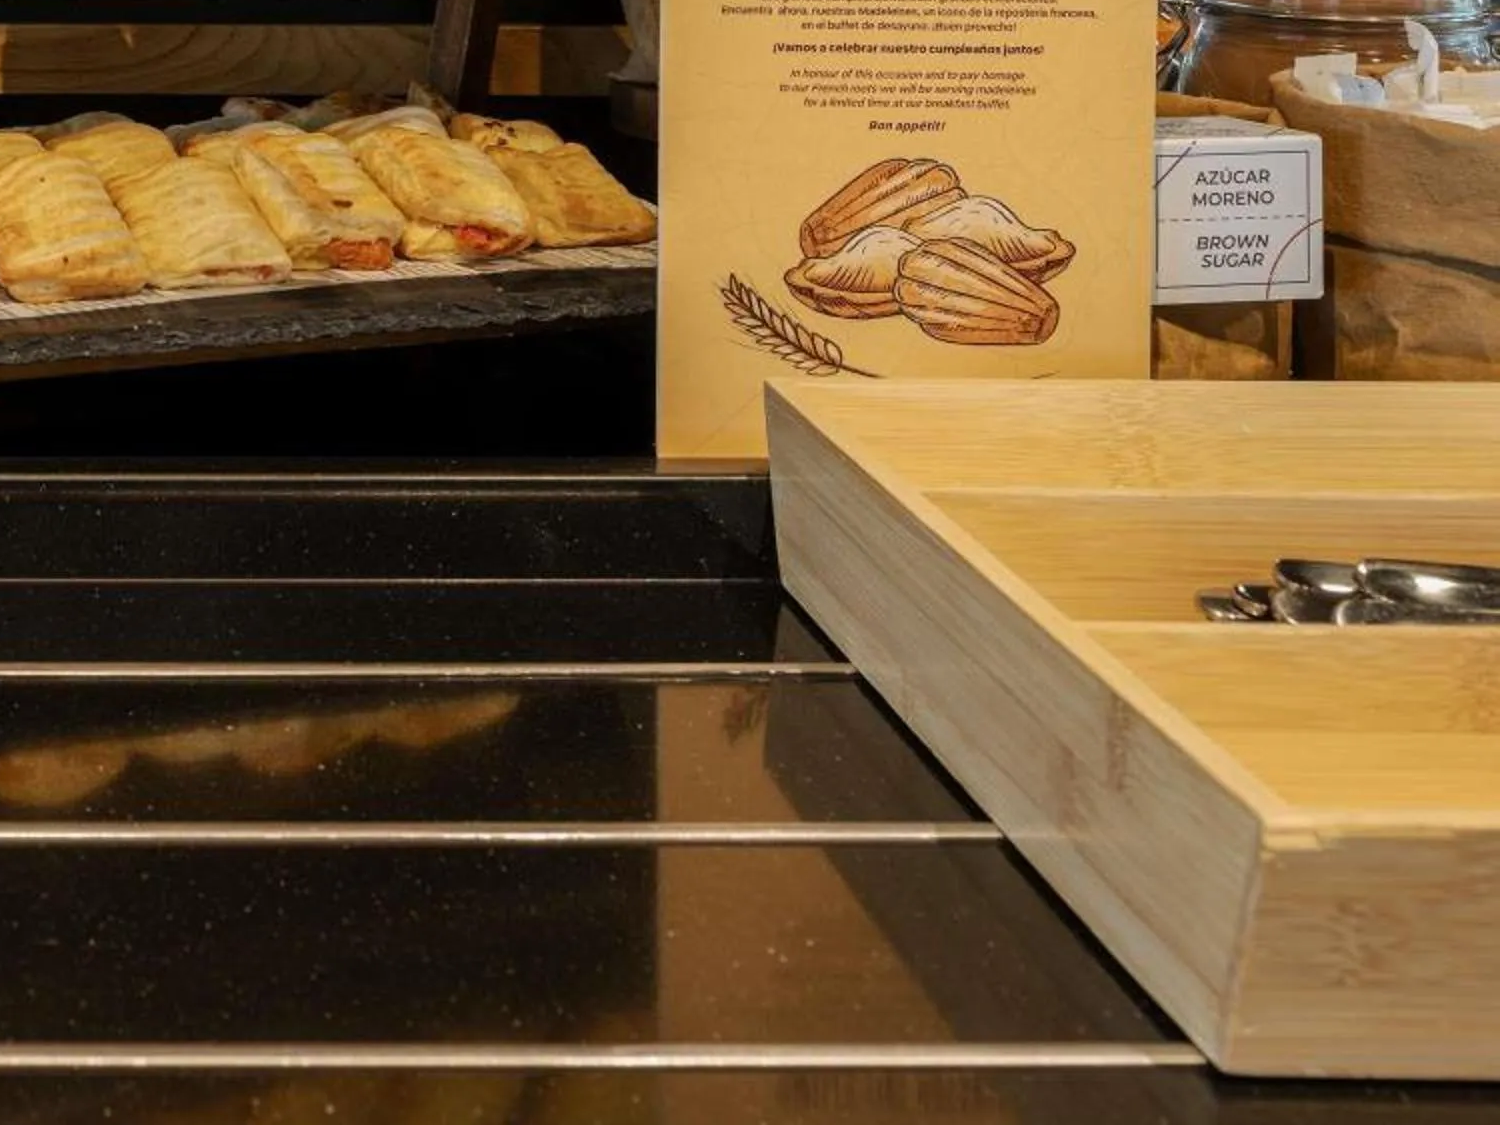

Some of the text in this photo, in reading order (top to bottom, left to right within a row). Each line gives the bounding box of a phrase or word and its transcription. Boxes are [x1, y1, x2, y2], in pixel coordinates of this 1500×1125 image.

[819, 45, 826, 53] a
[829, 42, 877, 53] celebrar
[881, 44, 926, 54] nuestro
[868, 120, 892, 131] Bon
[1194, 166, 1271, 186] AZÚCAR
[1191, 190, 1275, 207] MORENO
[1196, 234, 1269, 251] BROWN
[1201, 252, 1265, 268] SUGAR
